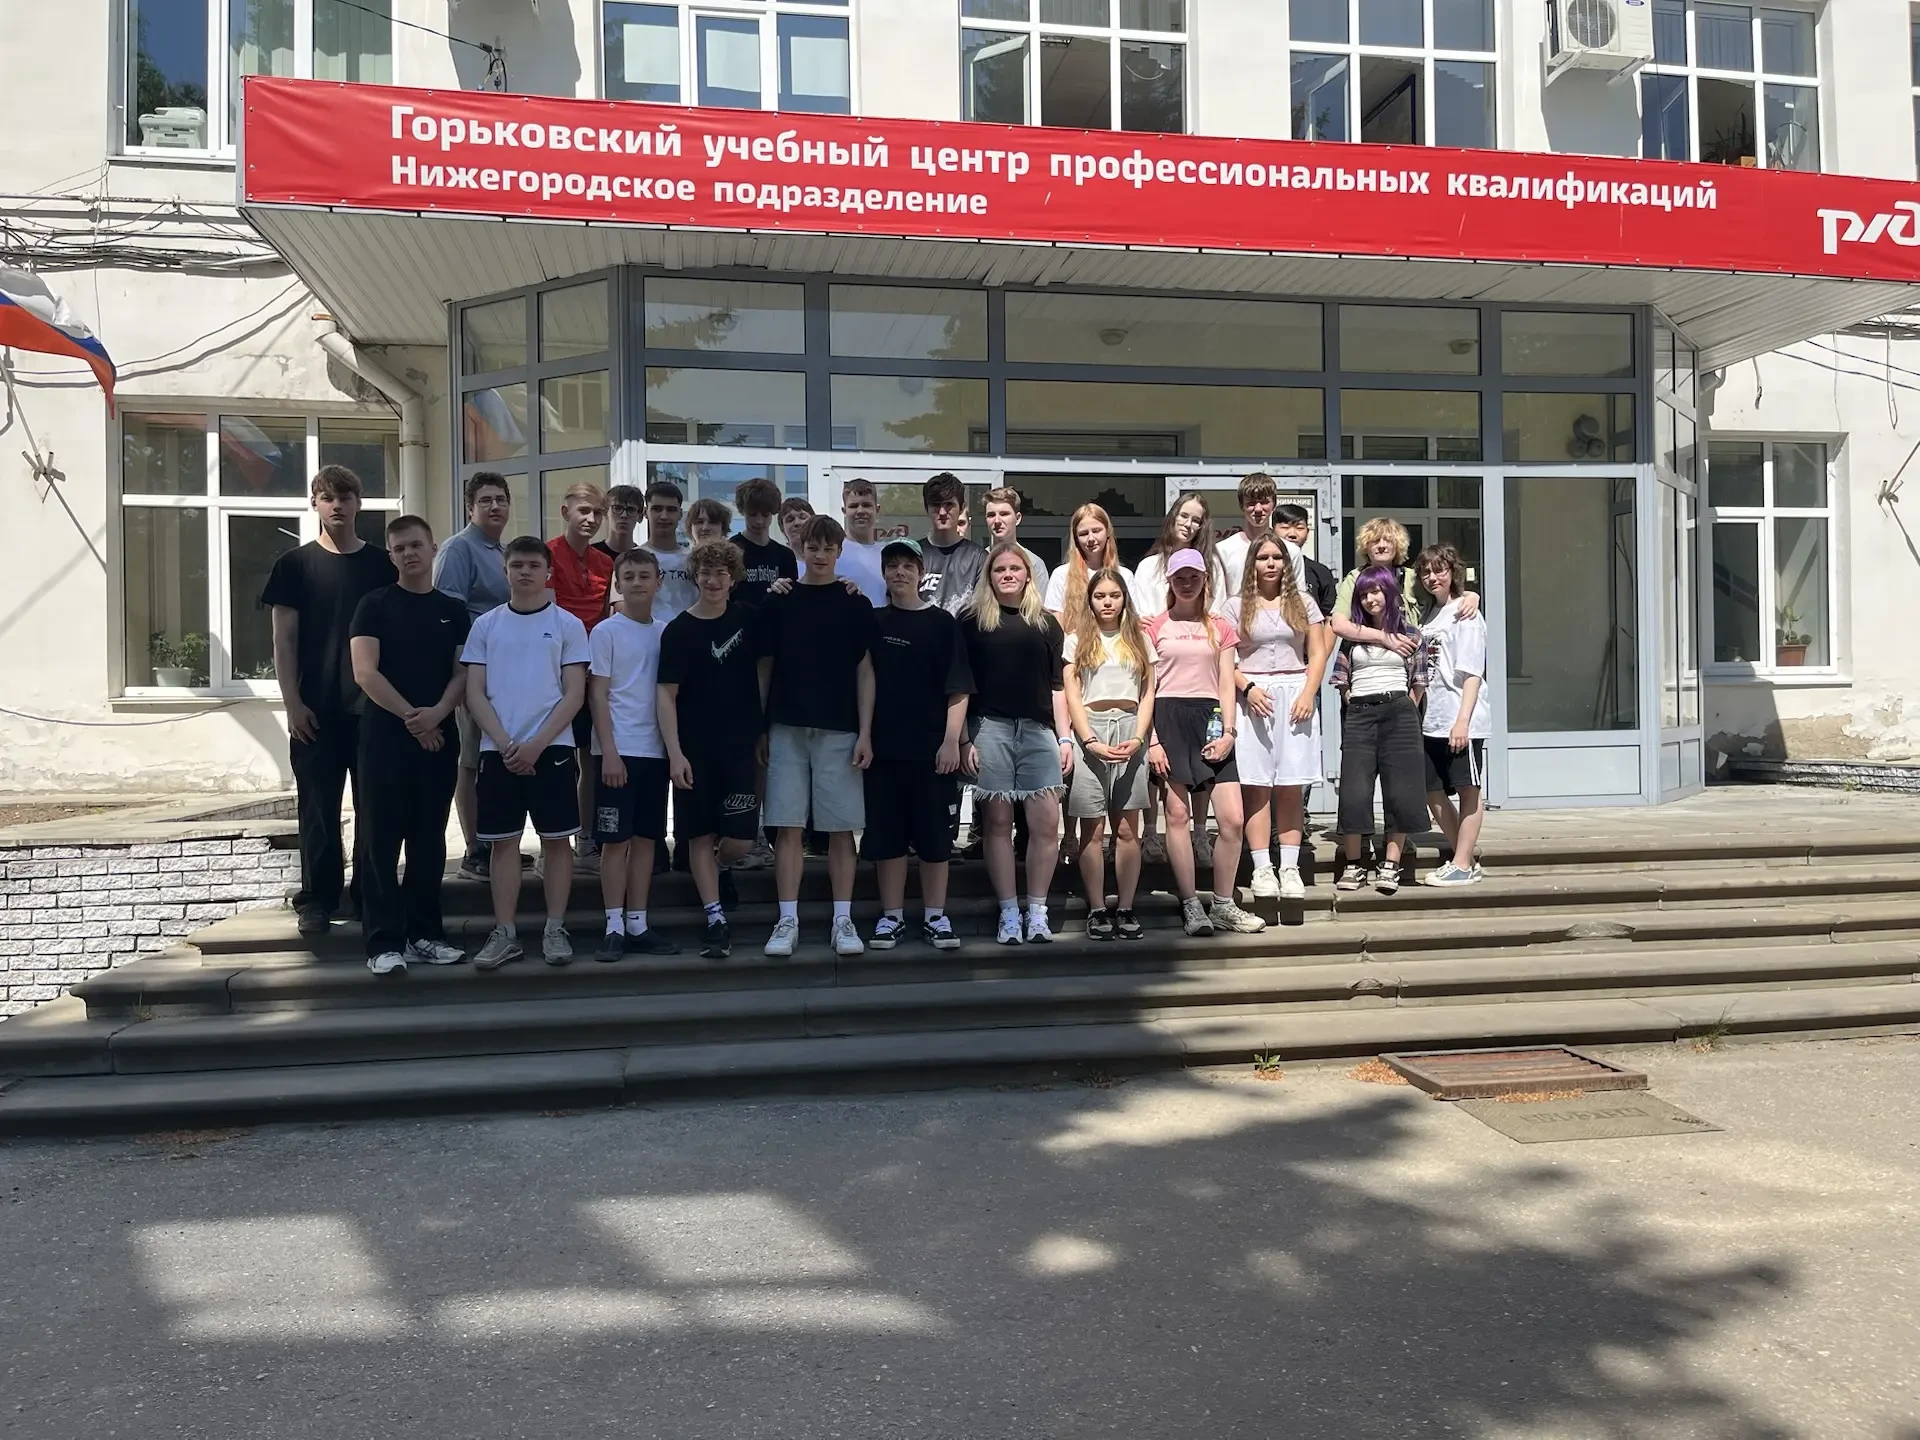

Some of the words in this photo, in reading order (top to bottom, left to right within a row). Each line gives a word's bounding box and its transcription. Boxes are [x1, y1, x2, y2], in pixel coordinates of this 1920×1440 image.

[391, 102, 682, 157] Горьковский
[703, 129, 889, 168] учебный
[911, 146, 1030, 183] центр
[1050, 149, 1430, 195] профессиональных
[1447, 171, 1717, 212] квалификаций
[391, 155, 696, 202] Нижегородское
[714, 181, 988, 215] подразделение
[1276, 498, 1312, 506] НИМАНИЕ
